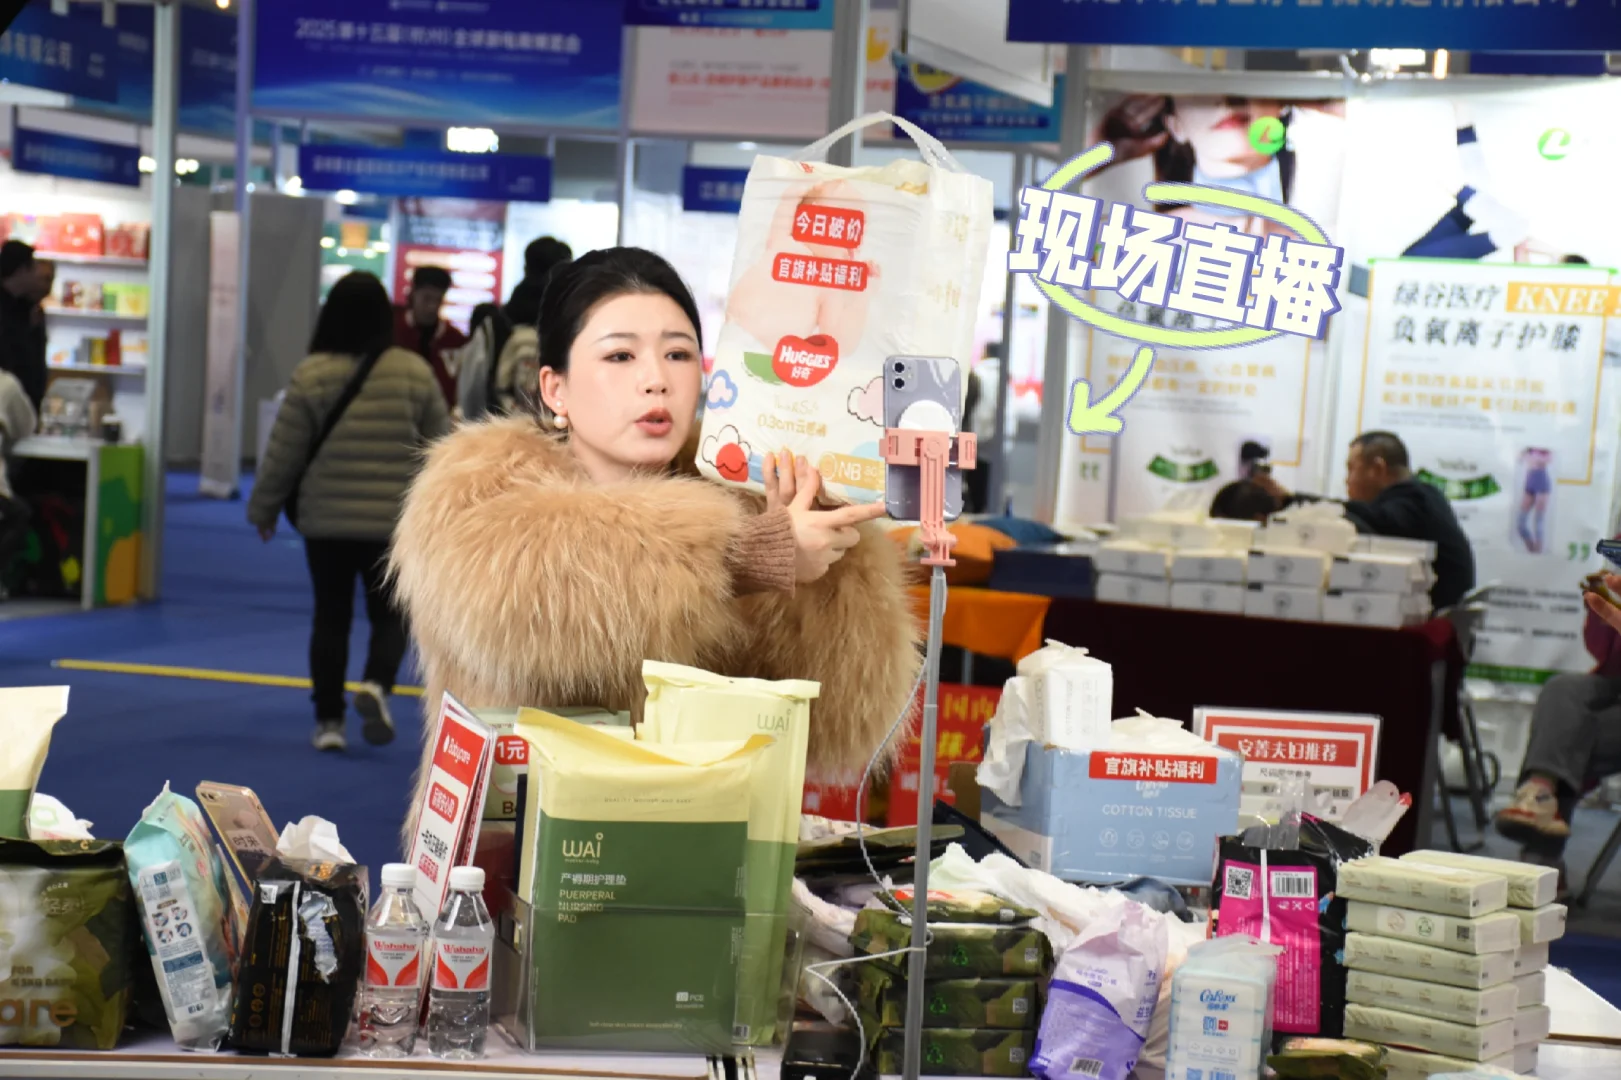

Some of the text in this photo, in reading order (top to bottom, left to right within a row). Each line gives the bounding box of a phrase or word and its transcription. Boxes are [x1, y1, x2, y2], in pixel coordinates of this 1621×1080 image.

[795, 211, 864, 244] 今日破价
[777, 257, 864, 287] 官旗补贴福利
[1516, 285, 1610, 314] KNEE
[779, 345, 832, 370] HUGGIES
[790, 365, 813, 382] 好奇
[837, 459, 862, 482] NB
[496, 740, 526, 761] 1元
[1237, 738, 1339, 763] 安菁夫妇推荐
[1104, 756, 1205, 780] 官旗补贴福利
[1102, 804, 1198, 820] COTTON TISSUE
[559, 889, 617, 901] PUERPERAL
[558, 901, 604, 913] NURSING
[558, 914, 577, 924] PAD
[374, 940, 417, 951] Wahaha
[443, 943, 486, 955] Wahaha
